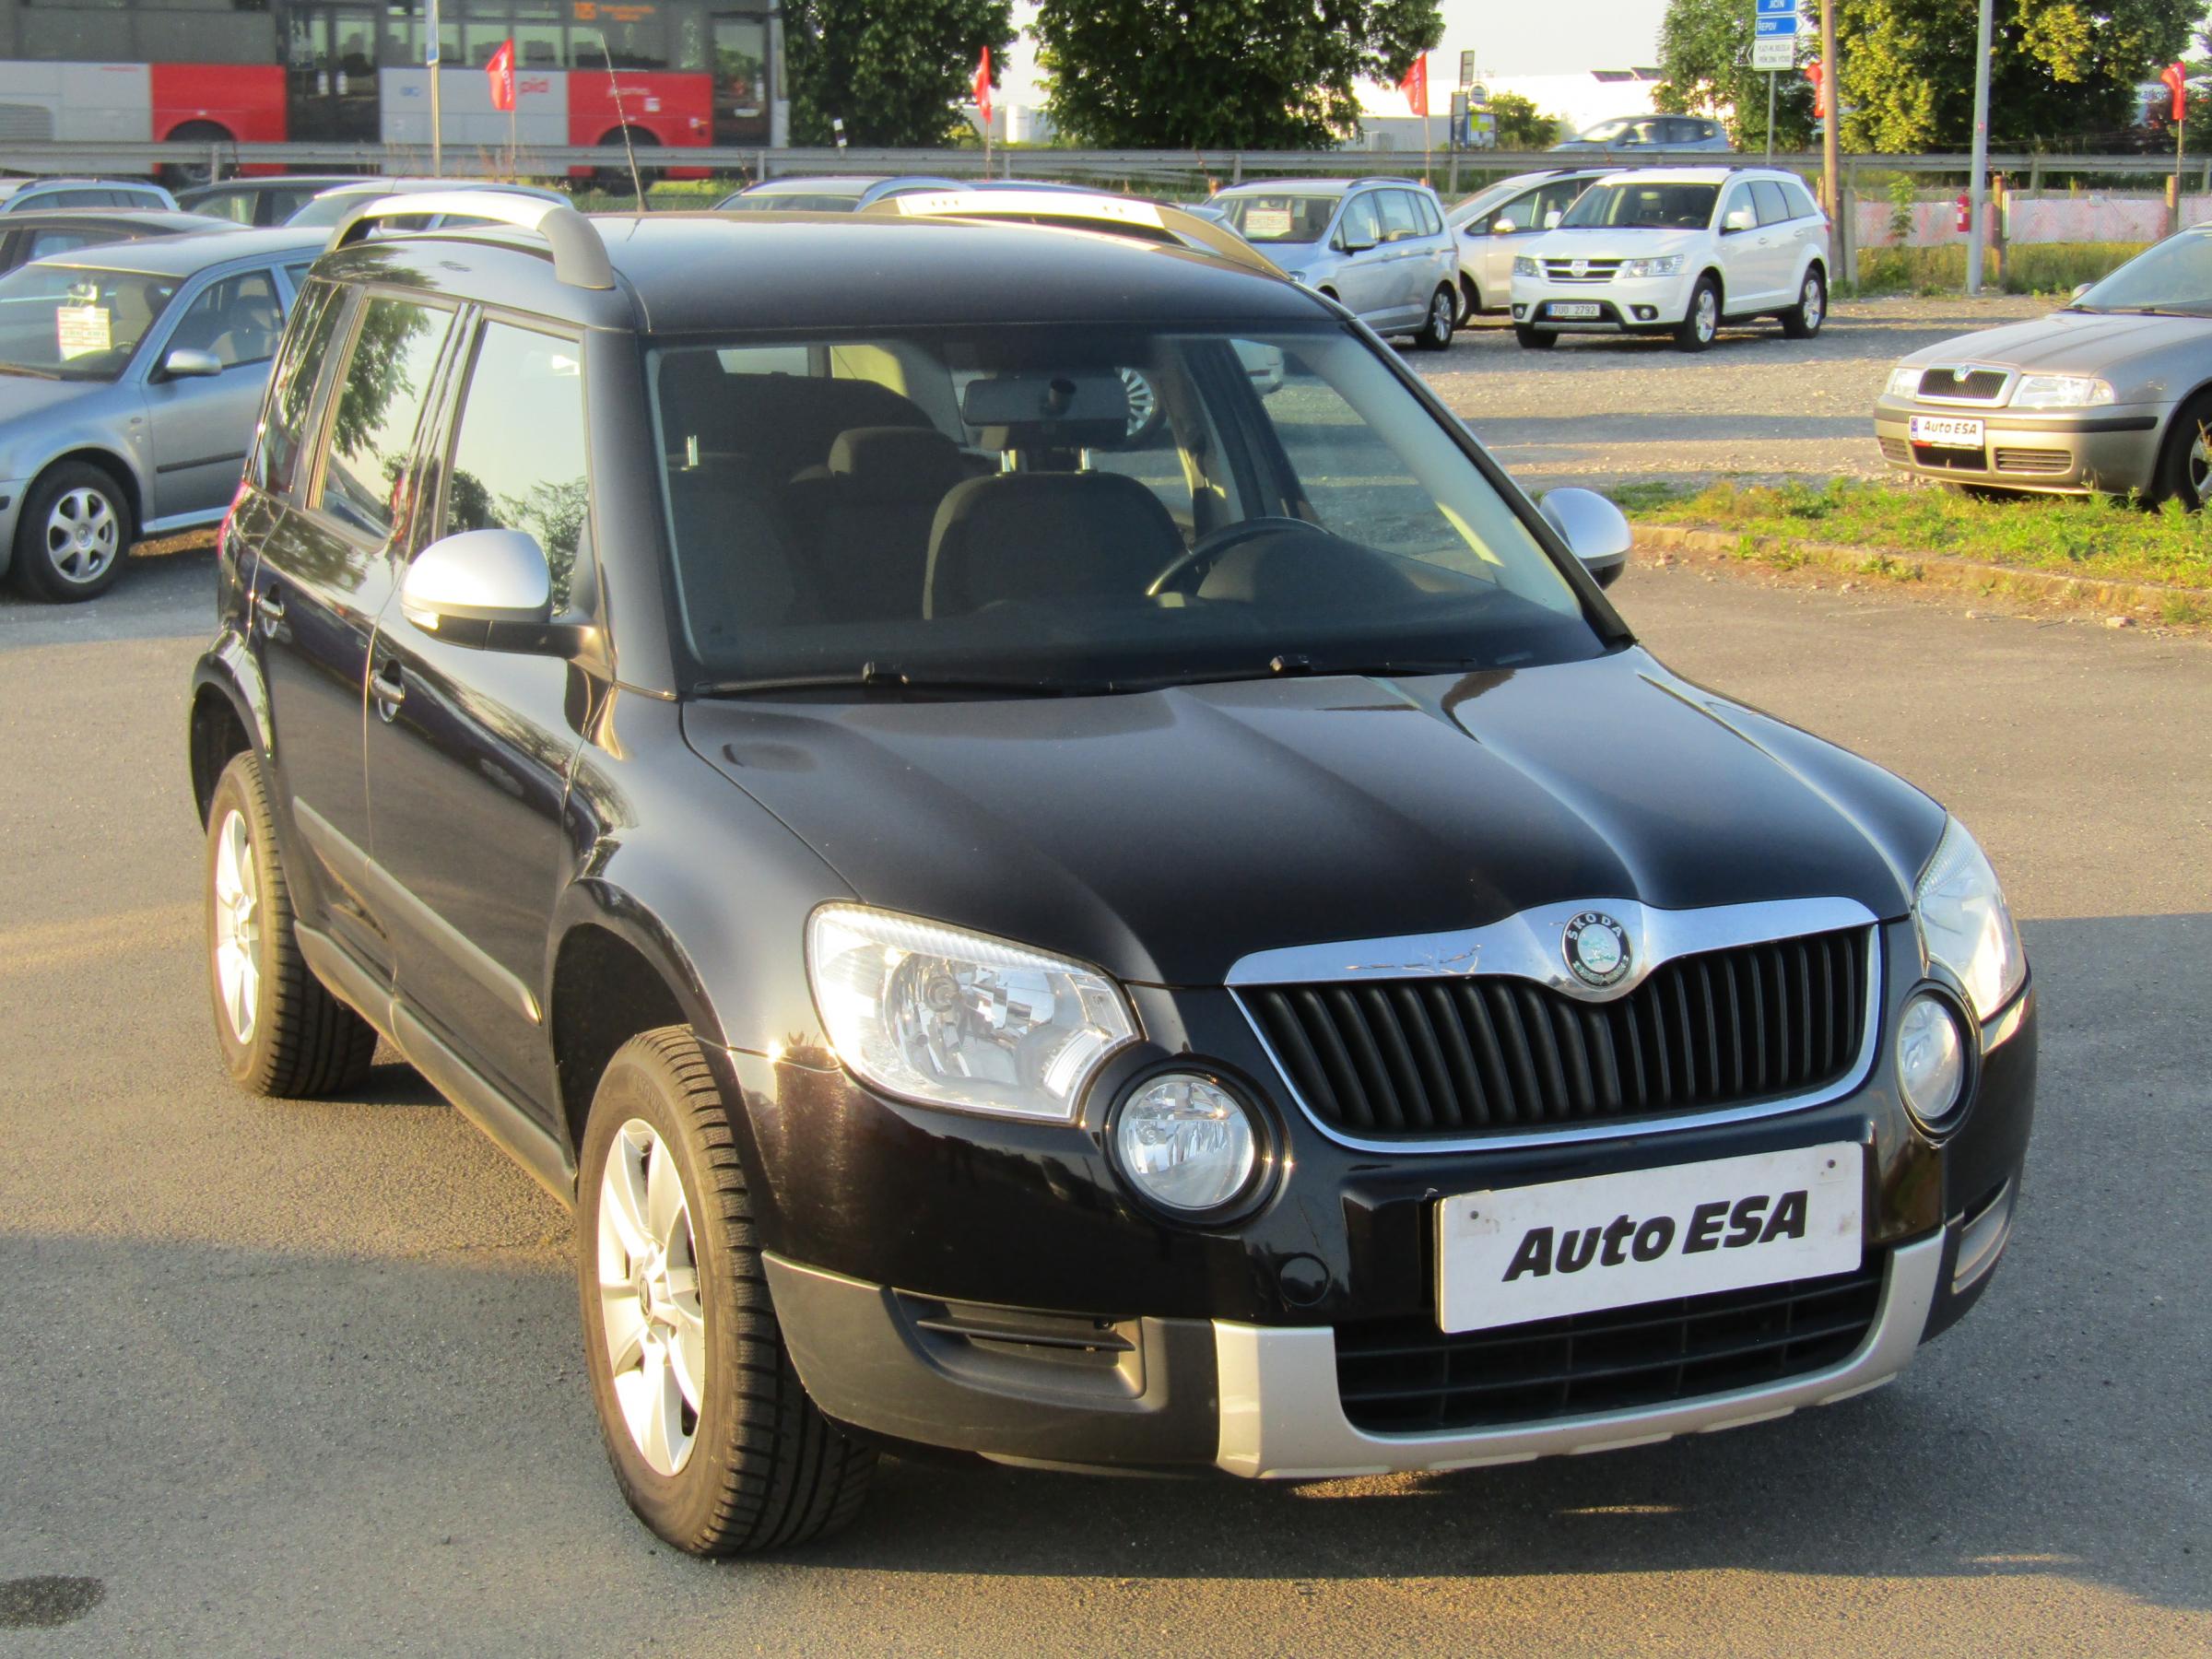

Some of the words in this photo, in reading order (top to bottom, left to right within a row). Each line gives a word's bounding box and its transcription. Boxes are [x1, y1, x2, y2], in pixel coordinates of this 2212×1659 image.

[1924, 420, 1952, 433] Auto
[1954, 423, 1977, 435] ESA
[1501, 1214, 1676, 1283] Auto
[1681, 1190, 1809, 1255] ESA
